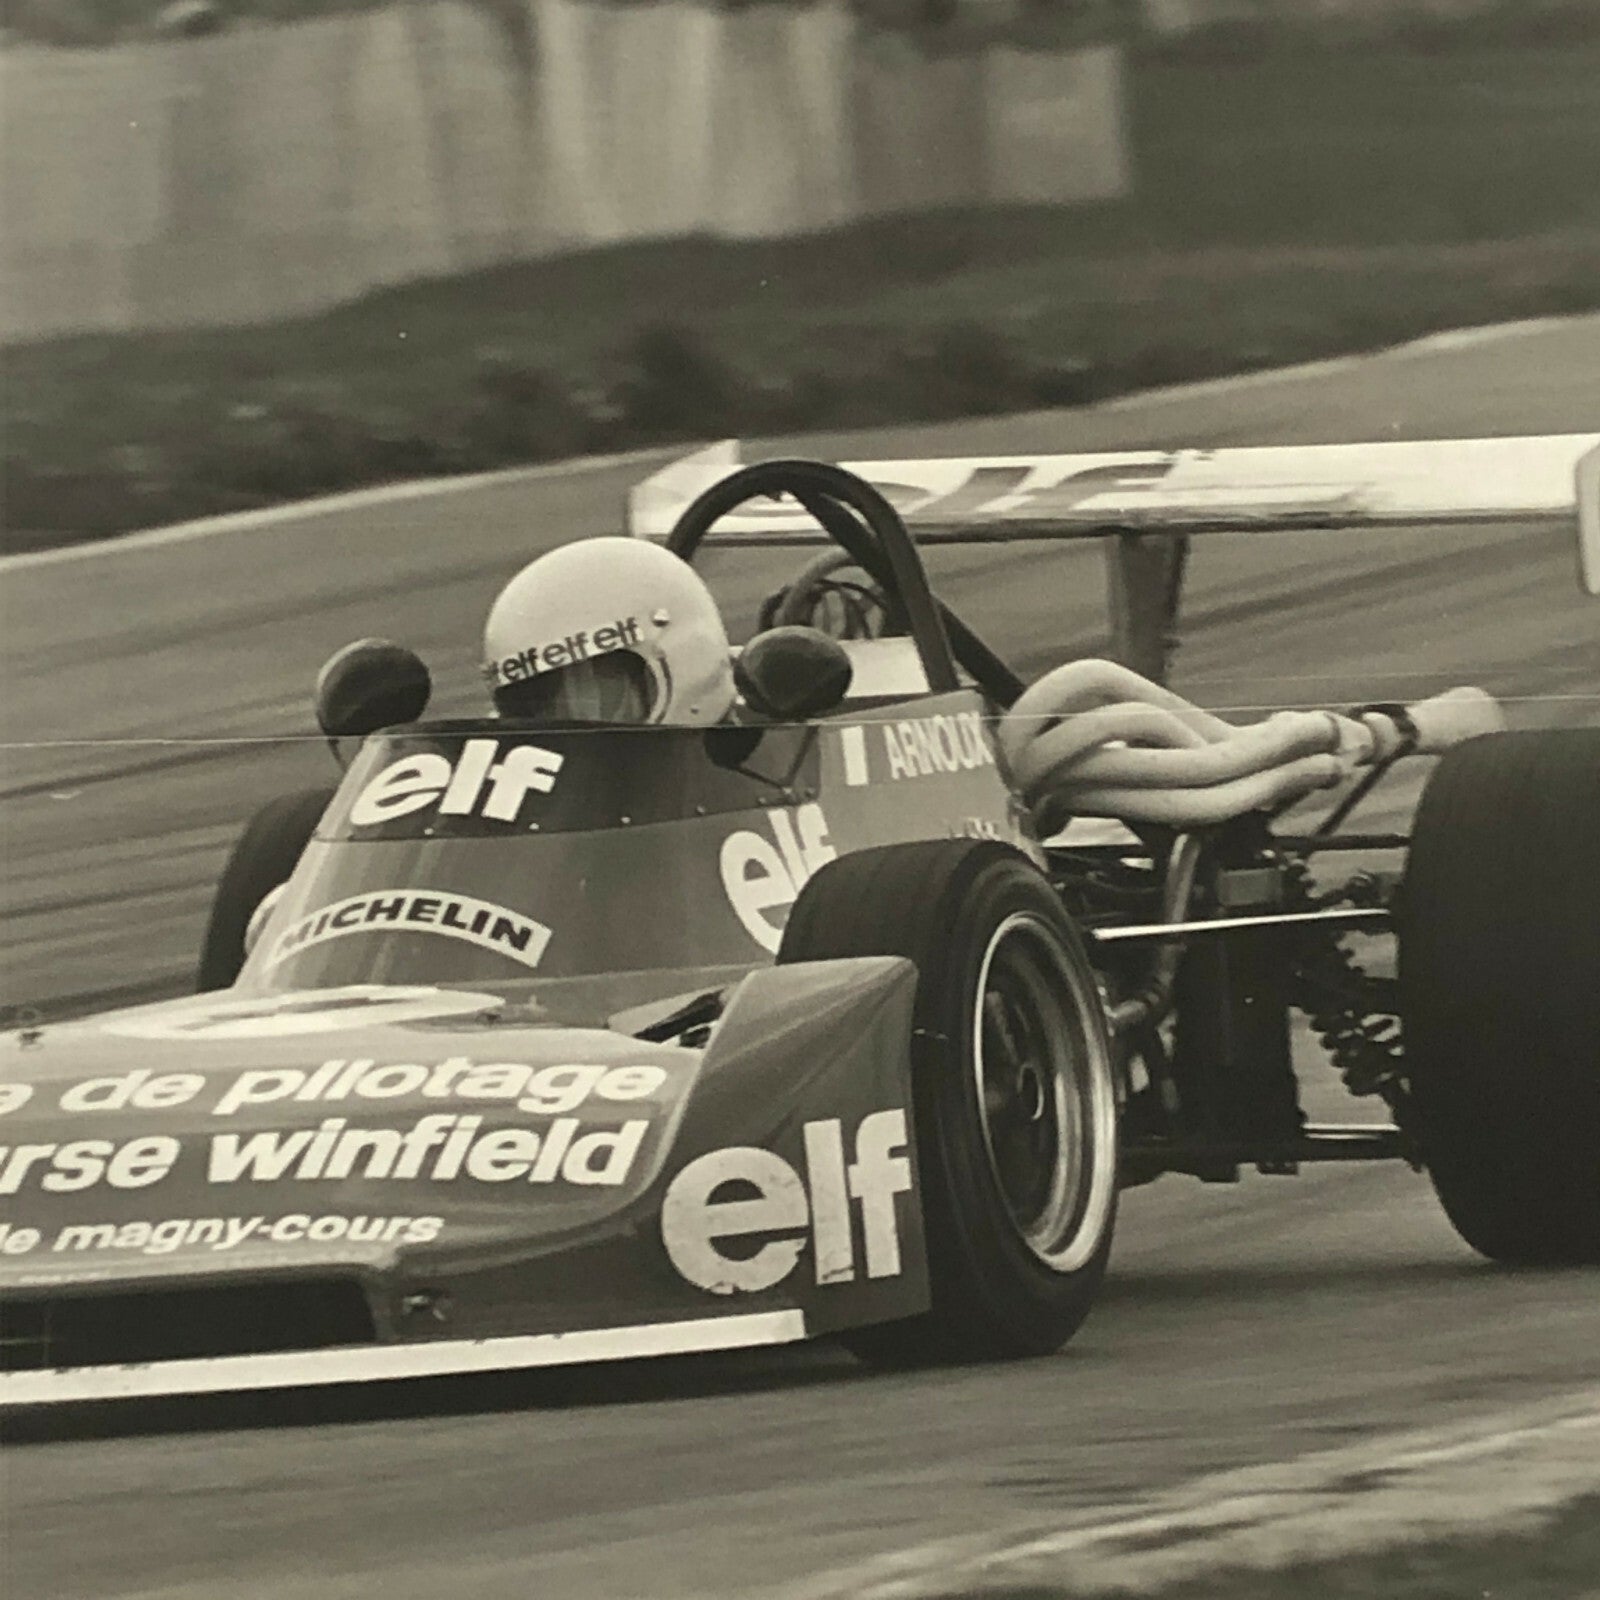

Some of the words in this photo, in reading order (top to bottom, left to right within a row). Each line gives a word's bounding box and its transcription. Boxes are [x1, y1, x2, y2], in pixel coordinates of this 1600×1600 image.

[502, 648, 539, 681] elf
[542, 632, 588, 663] elf
[593, 617, 638, 650] elf
[350, 739, 564, 825] elf
[882, 710, 996, 780] ARNOUX
[720, 803, 838, 955] elf
[59, 1068, 206, 1112] de
[211, 1057, 667, 1115] pilotage
[0, 1136, 180, 1194] rse
[208, 1114, 649, 1185] winfield
[53, 1215, 445, 1255] magny-cours
[661, 1108, 912, 1295] elf
